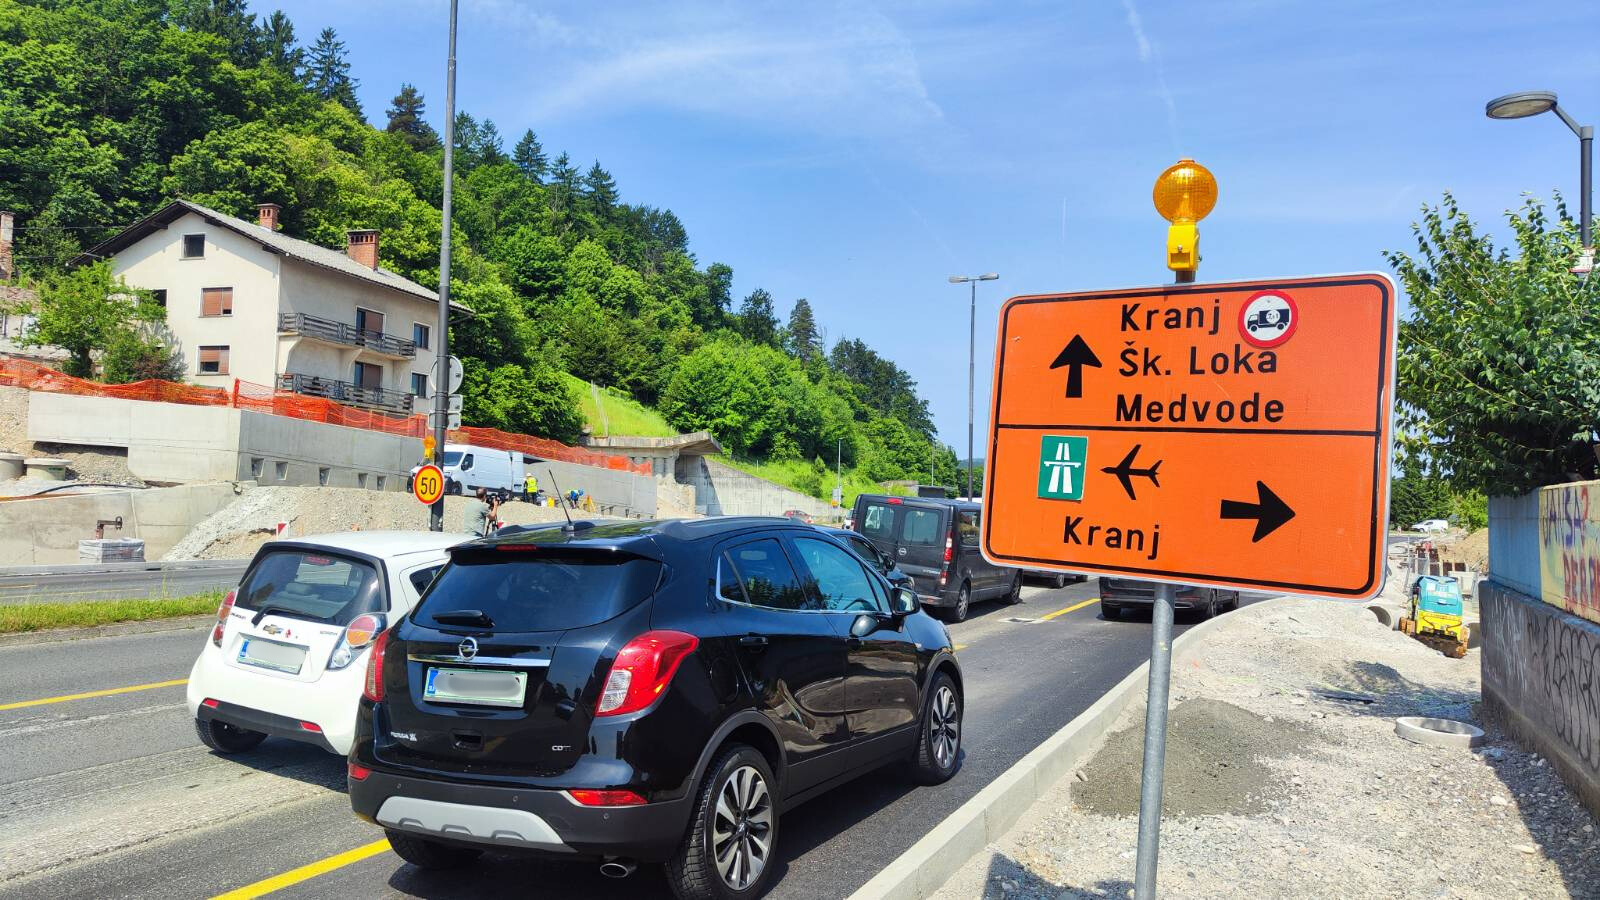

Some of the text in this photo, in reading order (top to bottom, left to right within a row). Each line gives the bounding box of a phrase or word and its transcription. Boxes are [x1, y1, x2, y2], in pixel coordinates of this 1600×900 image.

[1121, 298, 1220, 335] Kranj
[1119, 341, 1277, 377] Šk. Loka
[1116, 393, 1284, 423] Medvode
[420, 477, 437, 495] 50
[1063, 516, 1161, 561] Kranj
